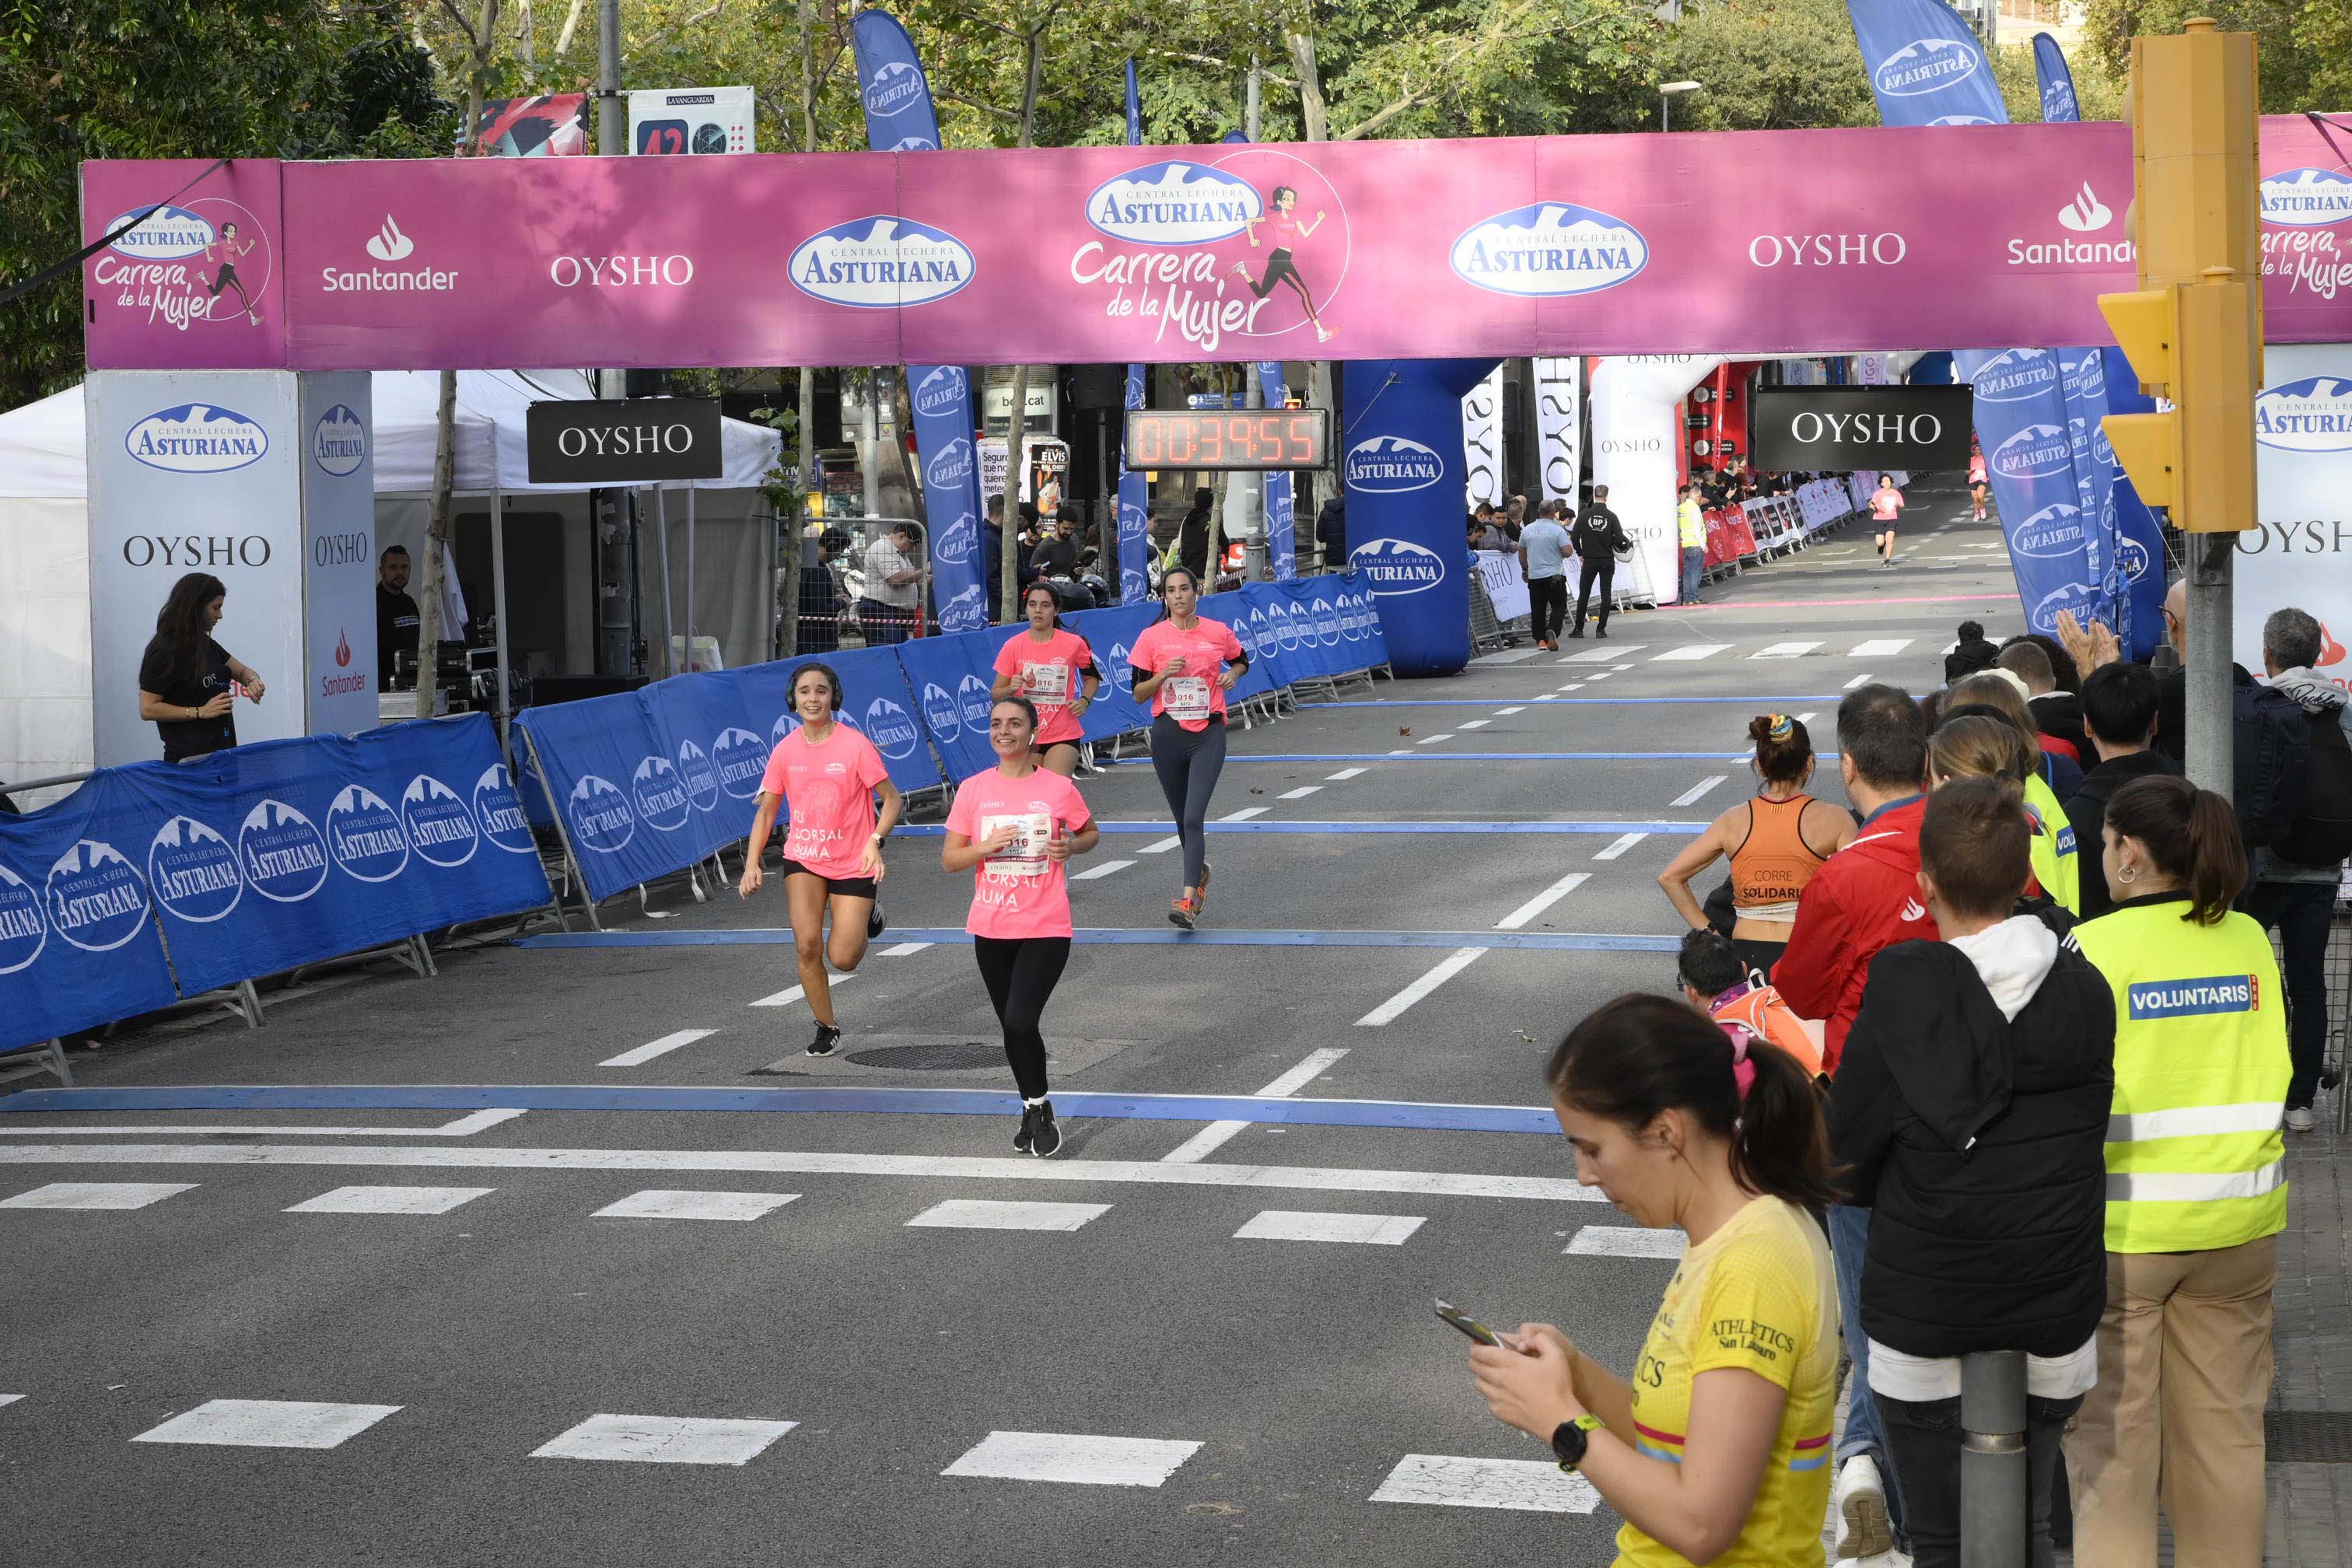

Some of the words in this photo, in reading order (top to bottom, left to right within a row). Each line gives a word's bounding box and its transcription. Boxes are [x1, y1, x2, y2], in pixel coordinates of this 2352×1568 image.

[1099, 193, 1248, 225] ASTURIANA
[114, 224, 206, 246] ASTURIANA
[1563, 233, 1626, 243] LECHERA
[1748, 233, 1906, 267] OYSHO
[2261, 230, 2336, 254] arrera
[803, 250, 961, 283] ASTURIANA
[831, 248, 889, 257] CENTRAL
[1070, 241, 1216, 285] Carrera
[1467, 237, 1633, 273] ASTURIANA
[2008, 238, 2137, 264] Santand
[2279, 254, 2294, 275] la
[95, 256, 187, 286] Carrera
[323, 267, 458, 292] Santander
[551, 255, 694, 286] OYSHO
[117, 285, 135, 307] de
[138, 287, 151, 306] la
[148, 282, 222, 331] Mujer
[1106, 286, 1134, 317] de
[1139, 285, 1159, 317] la
[1154, 278, 1271, 352] Mujer
[136, 429, 258, 456] ASTURIANA
[317, 430, 362, 458] ASTURIANA
[558, 424, 693, 457] OYSHO
[1138, 418, 1312, 461] 00:39:55
[1791, 413, 1941, 444] OYSHO
[1041, 451, 1066, 462] ELVIS
[1601, 438, 1661, 453] OYSHO
[1349, 458, 1436, 481] ASTURIANA
[1626, 526, 1662, 540] SHO
[124, 535, 271, 566] OYSHO
[316, 532, 367, 566] OYSHO
[322, 672, 366, 697] Santander
[334, 824, 406, 861] ASTURIANA
[408, 812, 474, 847] ASTURIANA
[247, 842, 324, 881] ASTURIANA
[1754, 870, 1793, 882] CORRE
[158, 859, 240, 901] ASTURIANA
[2132, 984, 2249, 1010] VOLUNTARIS
[1711, 1319, 1794, 1353] ATHLETICS
